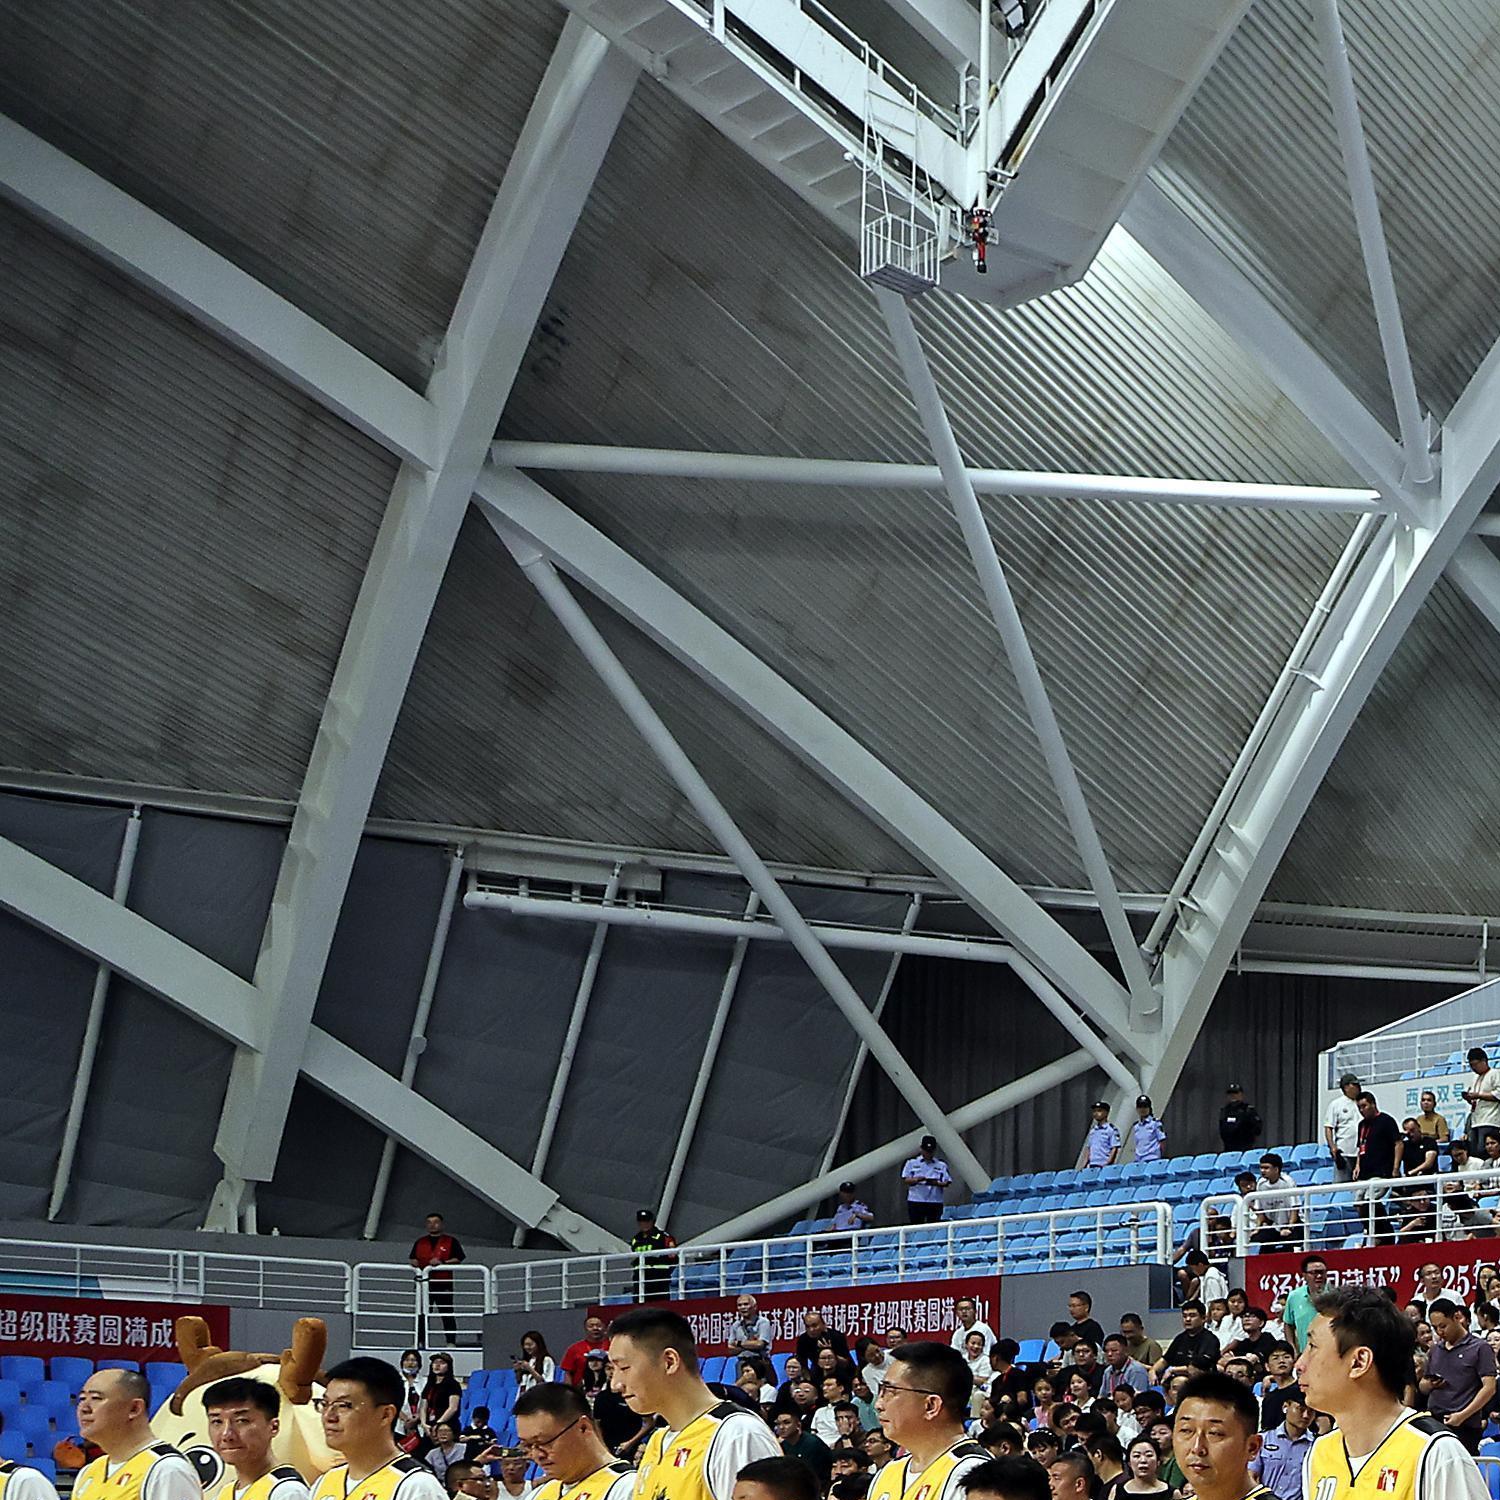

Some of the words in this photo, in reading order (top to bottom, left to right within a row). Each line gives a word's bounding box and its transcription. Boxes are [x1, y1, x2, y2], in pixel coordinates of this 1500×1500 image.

[0, 1309, 178, 1349] 超级联赛圆满成
